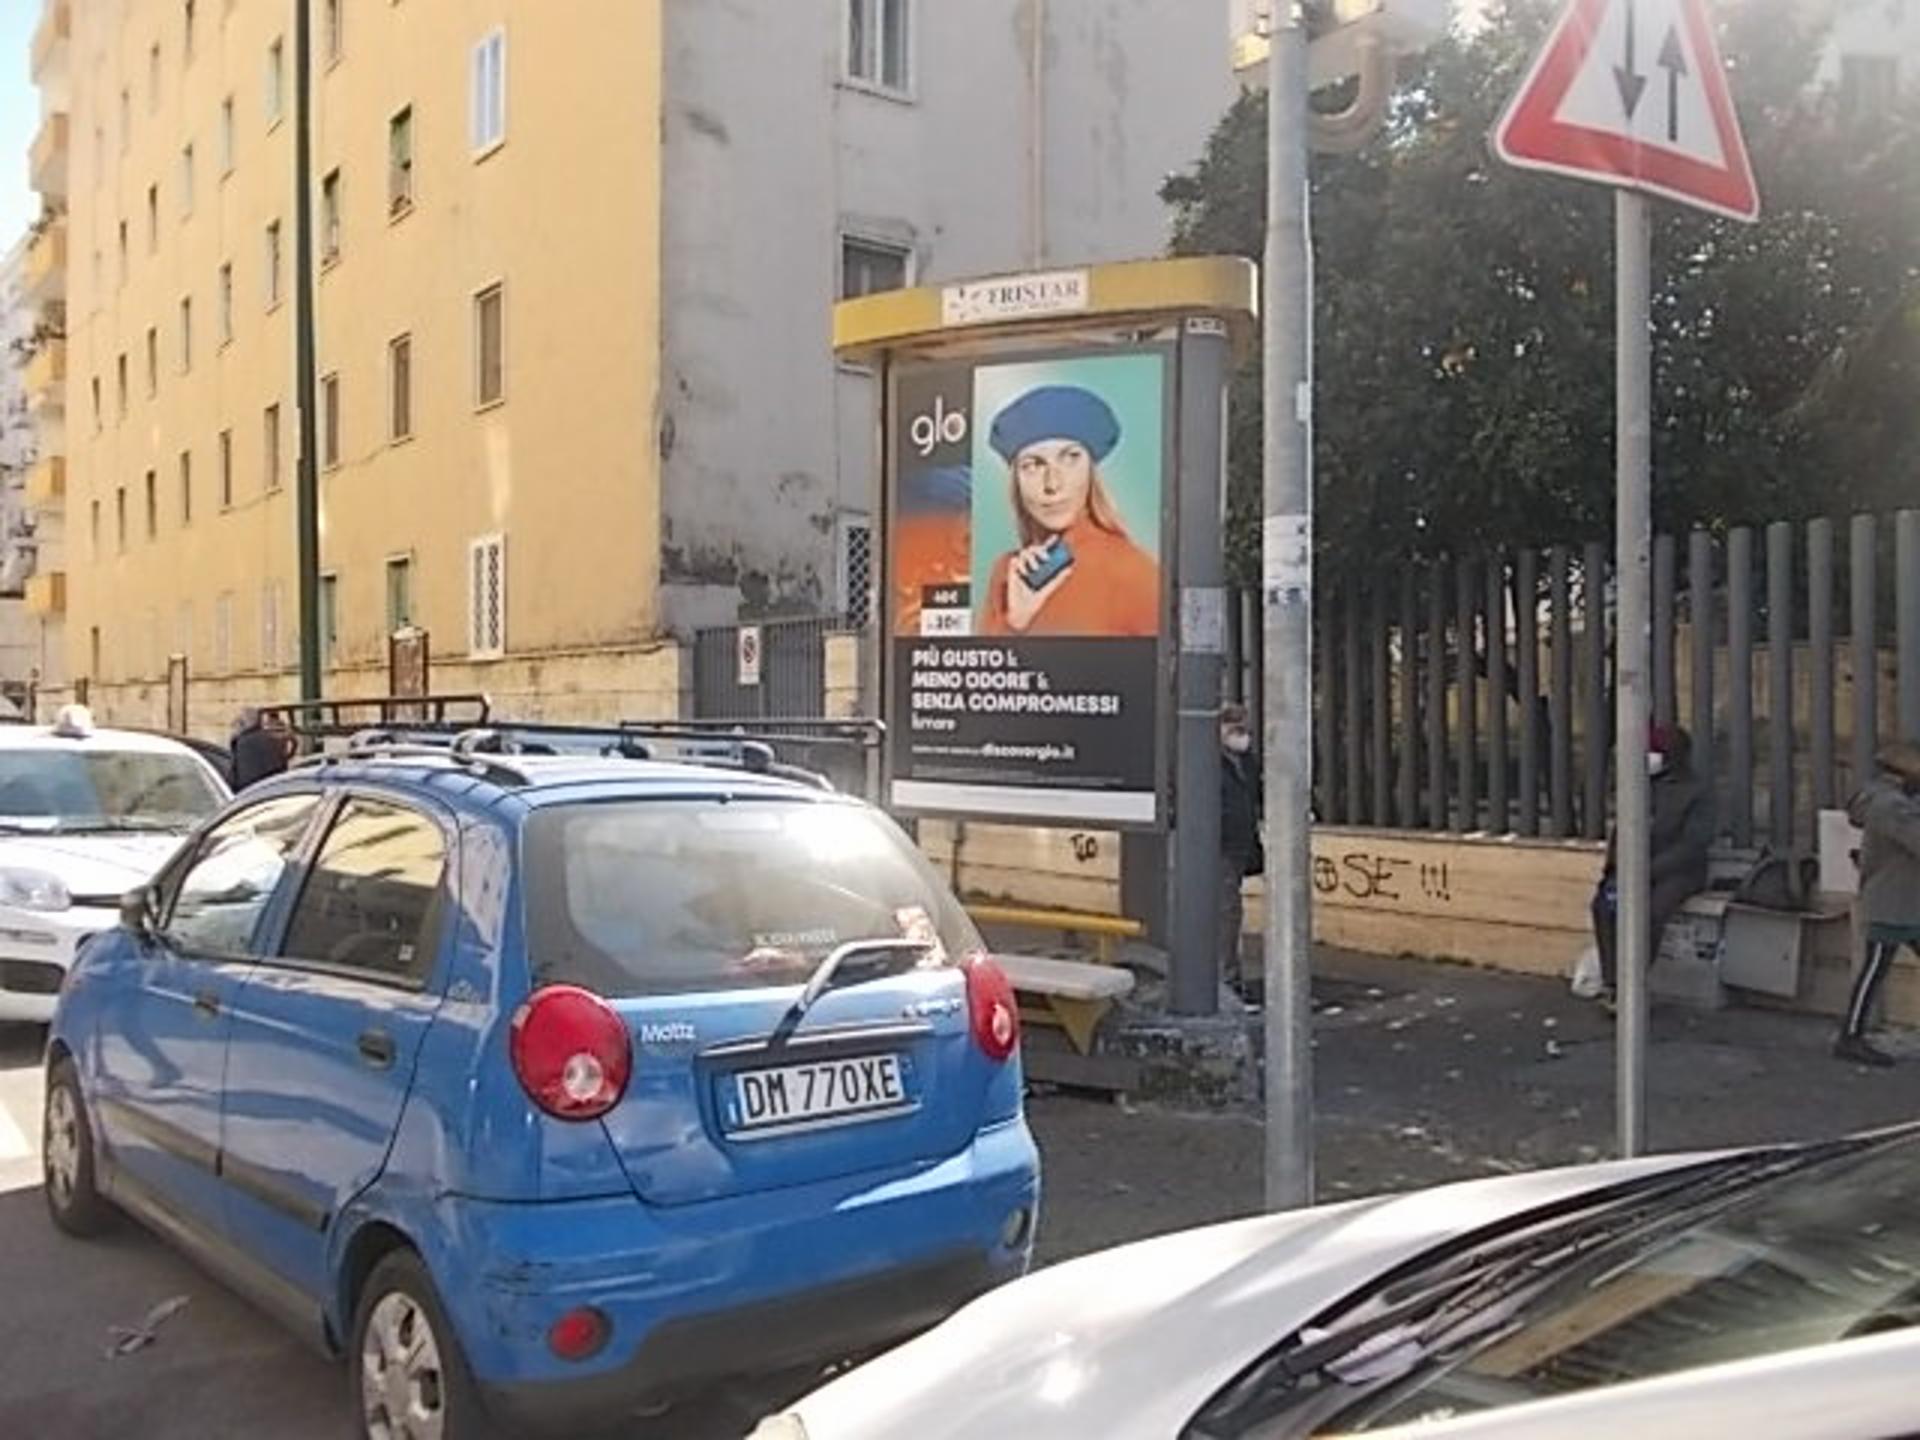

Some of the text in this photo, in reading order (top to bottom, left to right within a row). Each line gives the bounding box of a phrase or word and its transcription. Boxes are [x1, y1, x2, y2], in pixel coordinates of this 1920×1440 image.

[911, 396, 967, 456] glo
[942, 649, 1003, 667] GUSTO
[911, 671, 962, 689] MENO
[911, 692, 1120, 715] SENZA COMPROMESSI
[743, 1058, 898, 1119] DM 770XE
